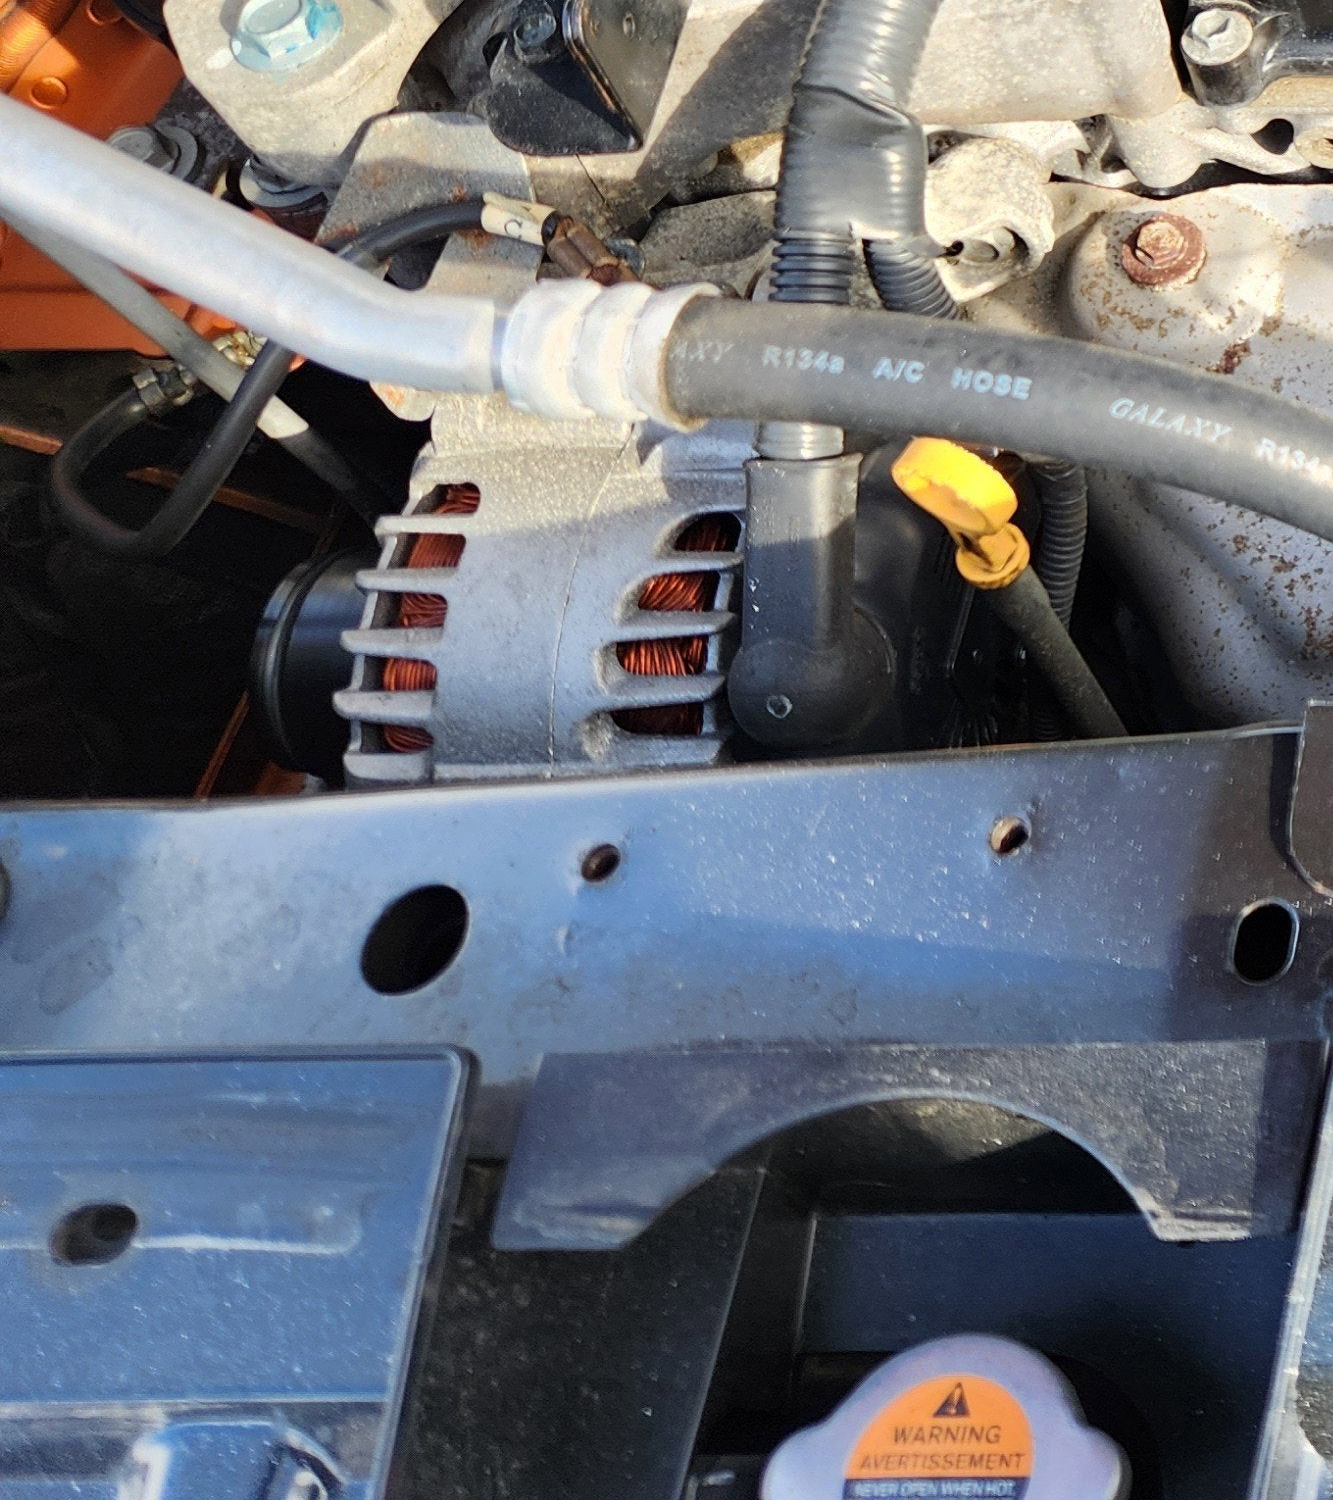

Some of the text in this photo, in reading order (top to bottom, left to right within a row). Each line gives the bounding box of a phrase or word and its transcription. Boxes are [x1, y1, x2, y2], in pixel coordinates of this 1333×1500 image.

[872, 355, 927, 384] A/C
[950, 366, 1033, 401] HOSE
[1109, 396, 1233, 444] GALAXY
[892, 1424, 1002, 1445] WARNING
[860, 1452, 1026, 1471] AVERTISSEMENT
